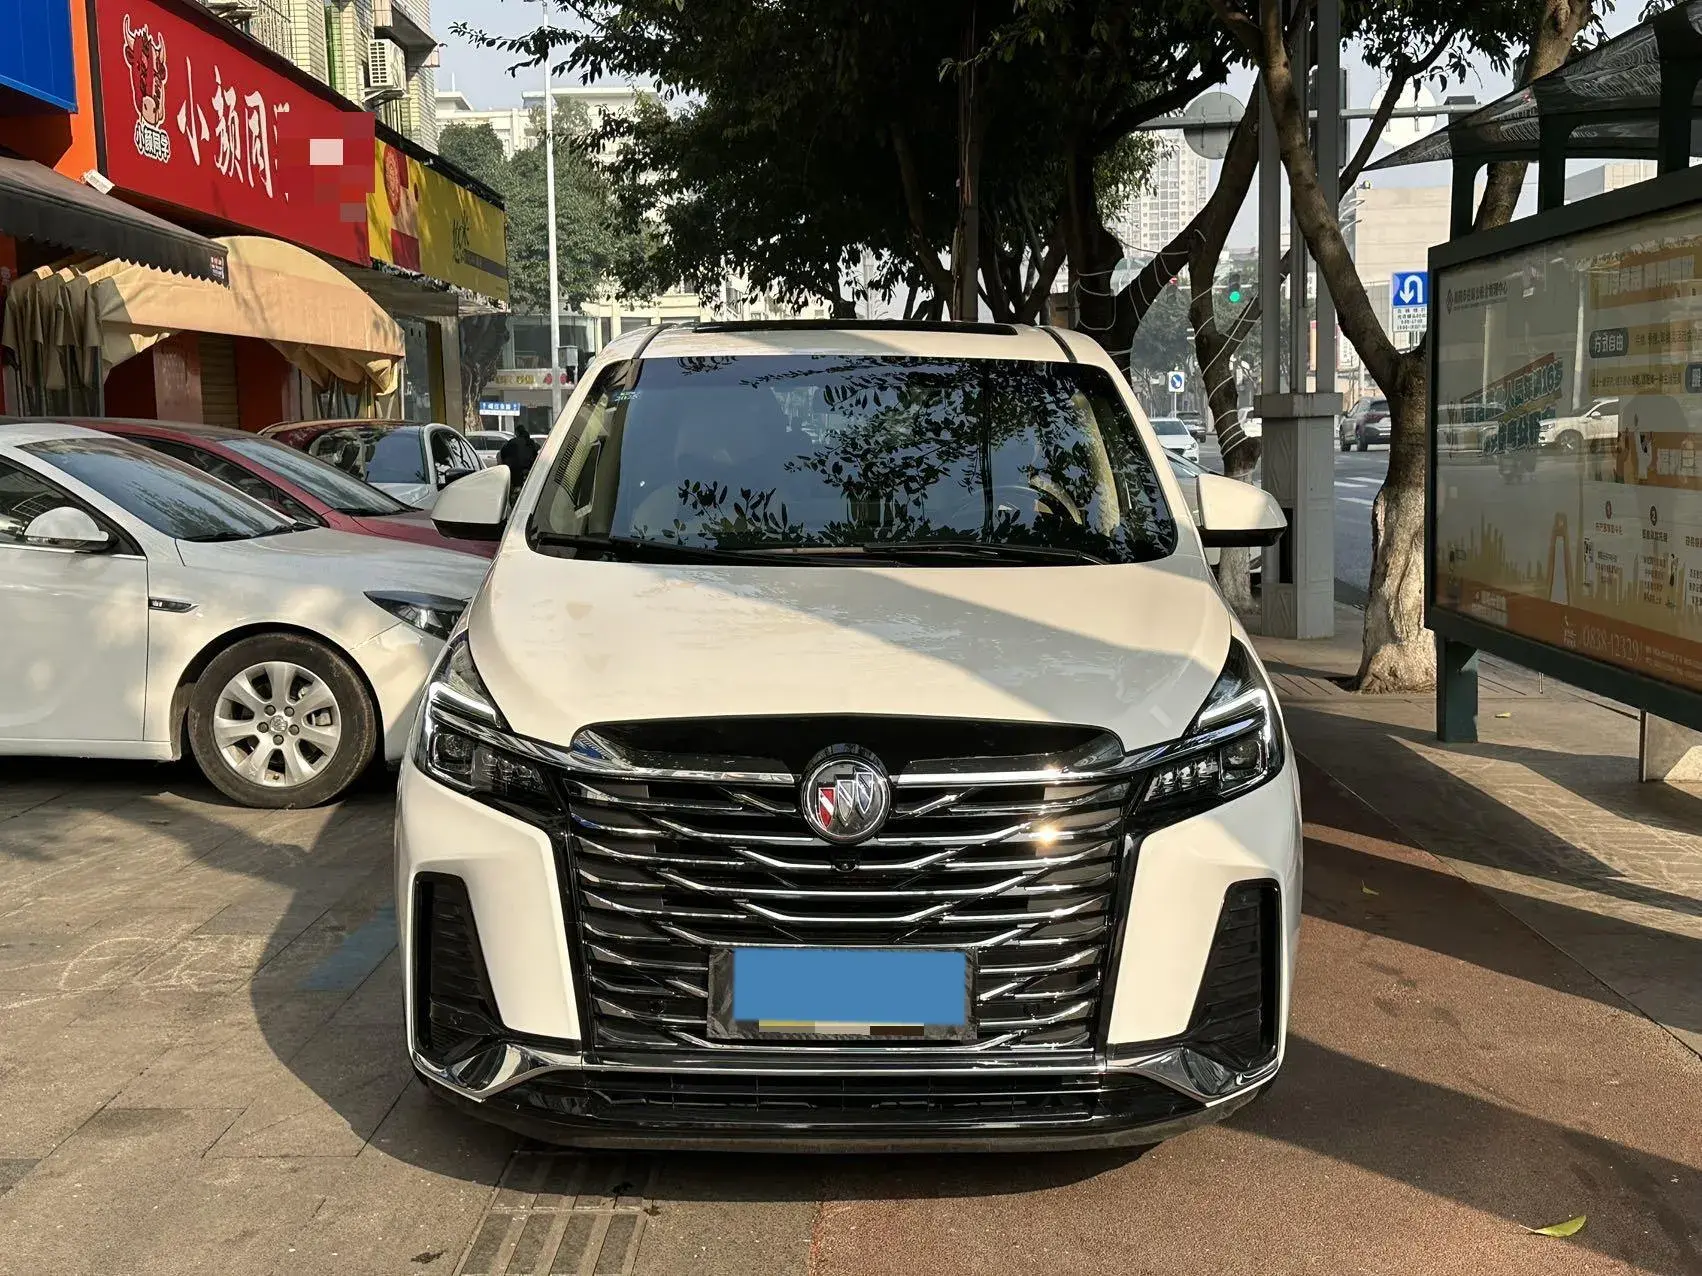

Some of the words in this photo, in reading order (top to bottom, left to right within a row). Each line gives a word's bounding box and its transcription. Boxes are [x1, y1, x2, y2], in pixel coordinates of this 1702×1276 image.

[135, 121, 170, 162] 小颜同学
[176, 56, 290, 202] 小颜同
[1594, 333, 1624, 353] 方式自由
[1582, 625, 1639, 663] 0838-12329
